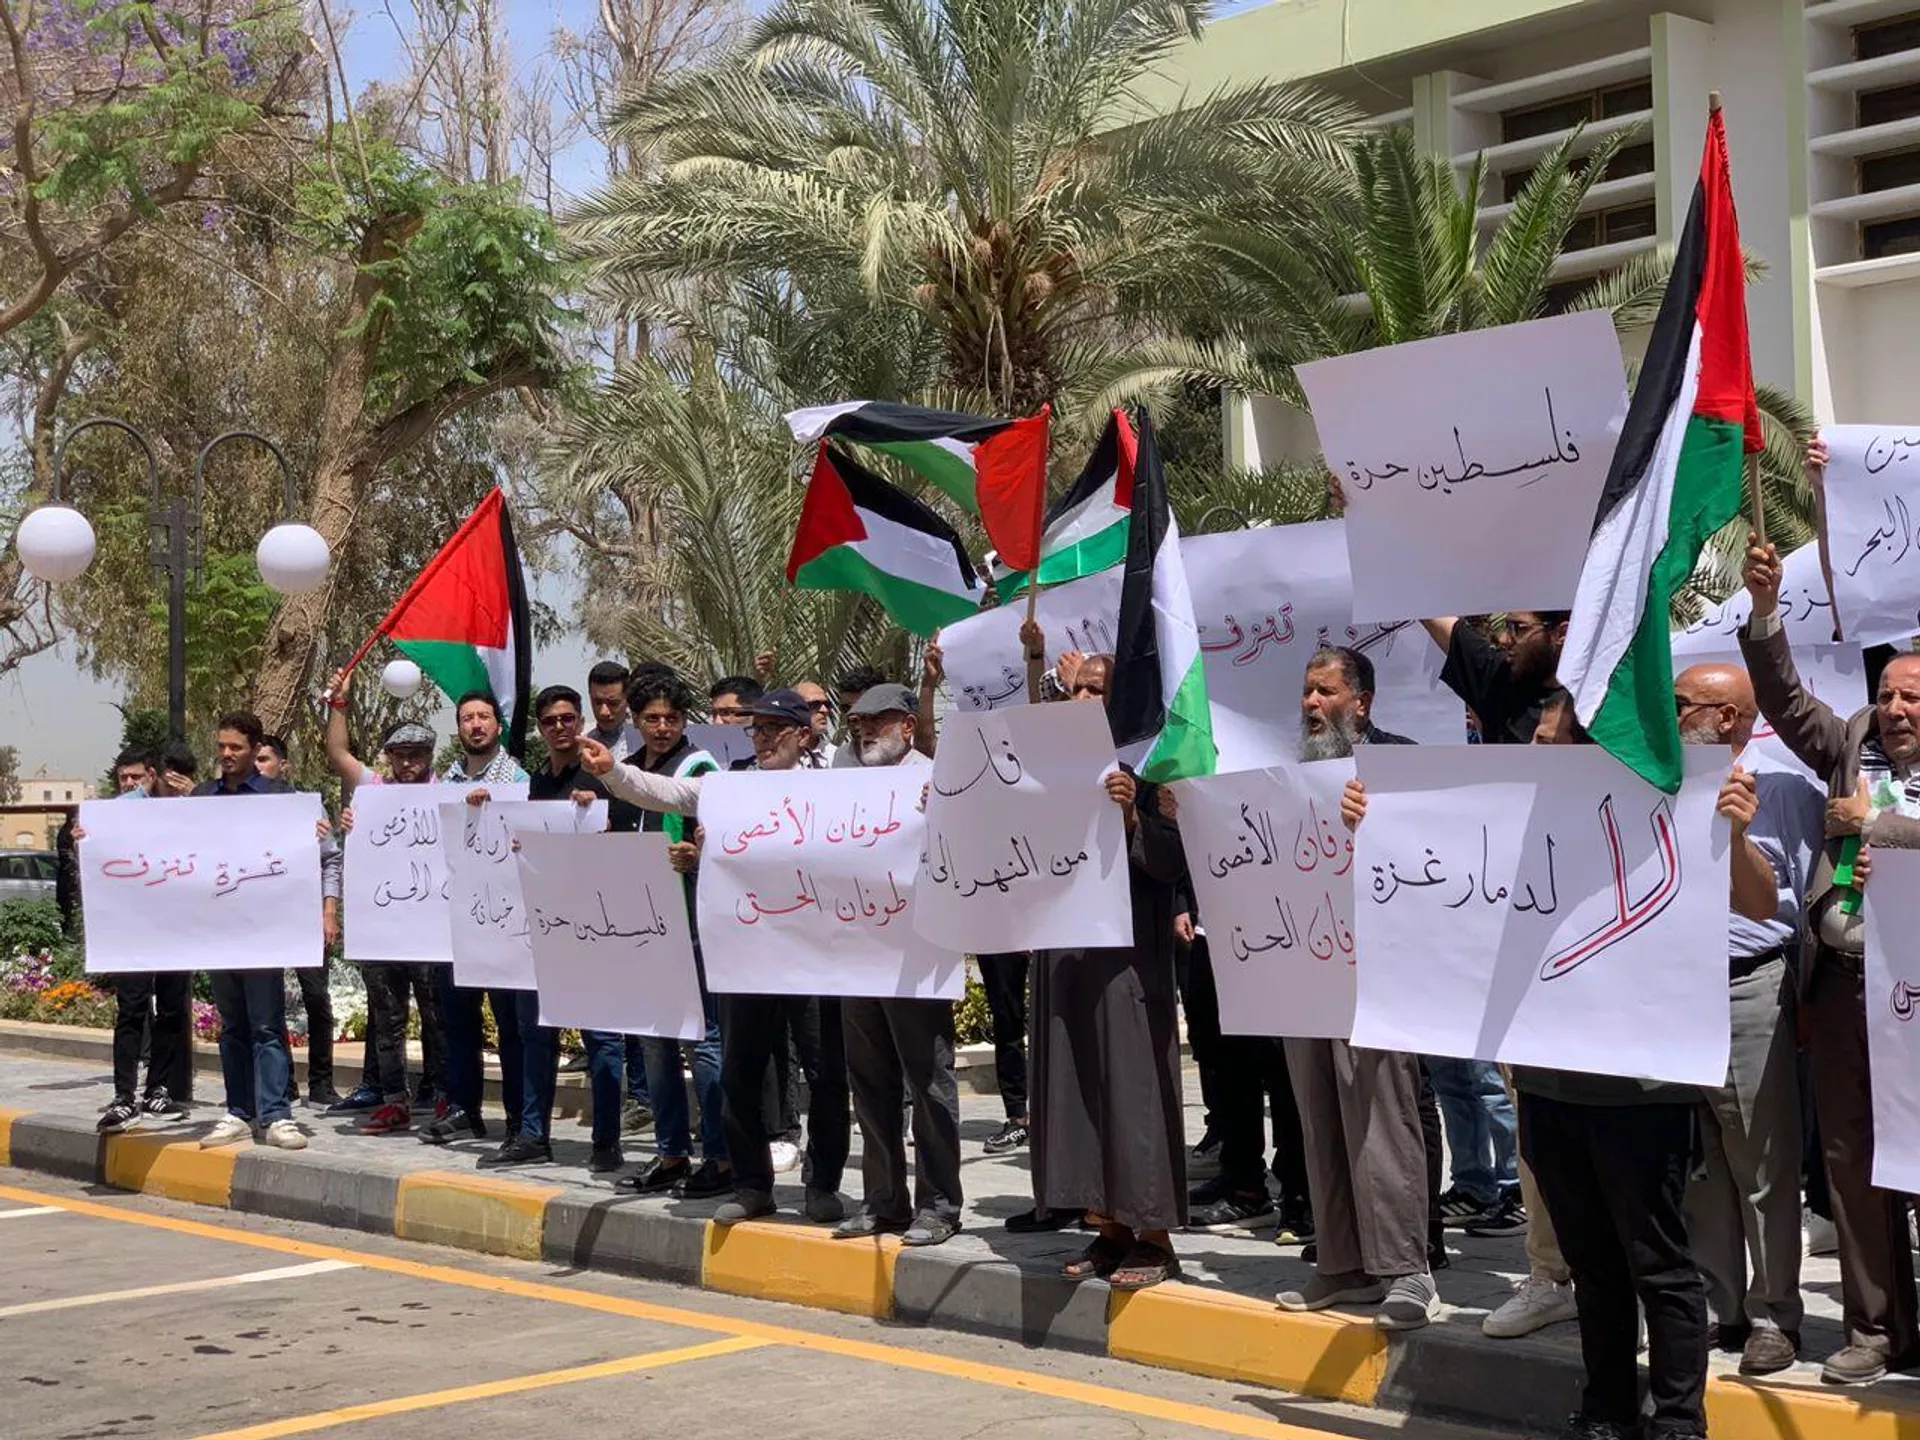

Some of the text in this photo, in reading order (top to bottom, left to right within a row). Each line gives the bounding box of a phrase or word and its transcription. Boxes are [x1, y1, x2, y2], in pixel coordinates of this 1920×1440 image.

[1347, 387, 1580, 495] فلسطين حرة
[721, 791, 901, 854] طوفان الأقصى
[1208, 795, 1354, 878] وفان الأقصى
[101, 851, 289, 899] غزة تنزف
[373, 860, 431, 907] الحق
[961, 834, 1040, 897] النهر
[1050, 848, 1088, 876] من
[1371, 848, 1447, 904] غزة
[535, 907, 571, 935] حرة
[574, 883, 667, 948] فلسطين
[735, 867, 908, 926] طوفان الحق
[1231, 895, 1302, 962] الحق
